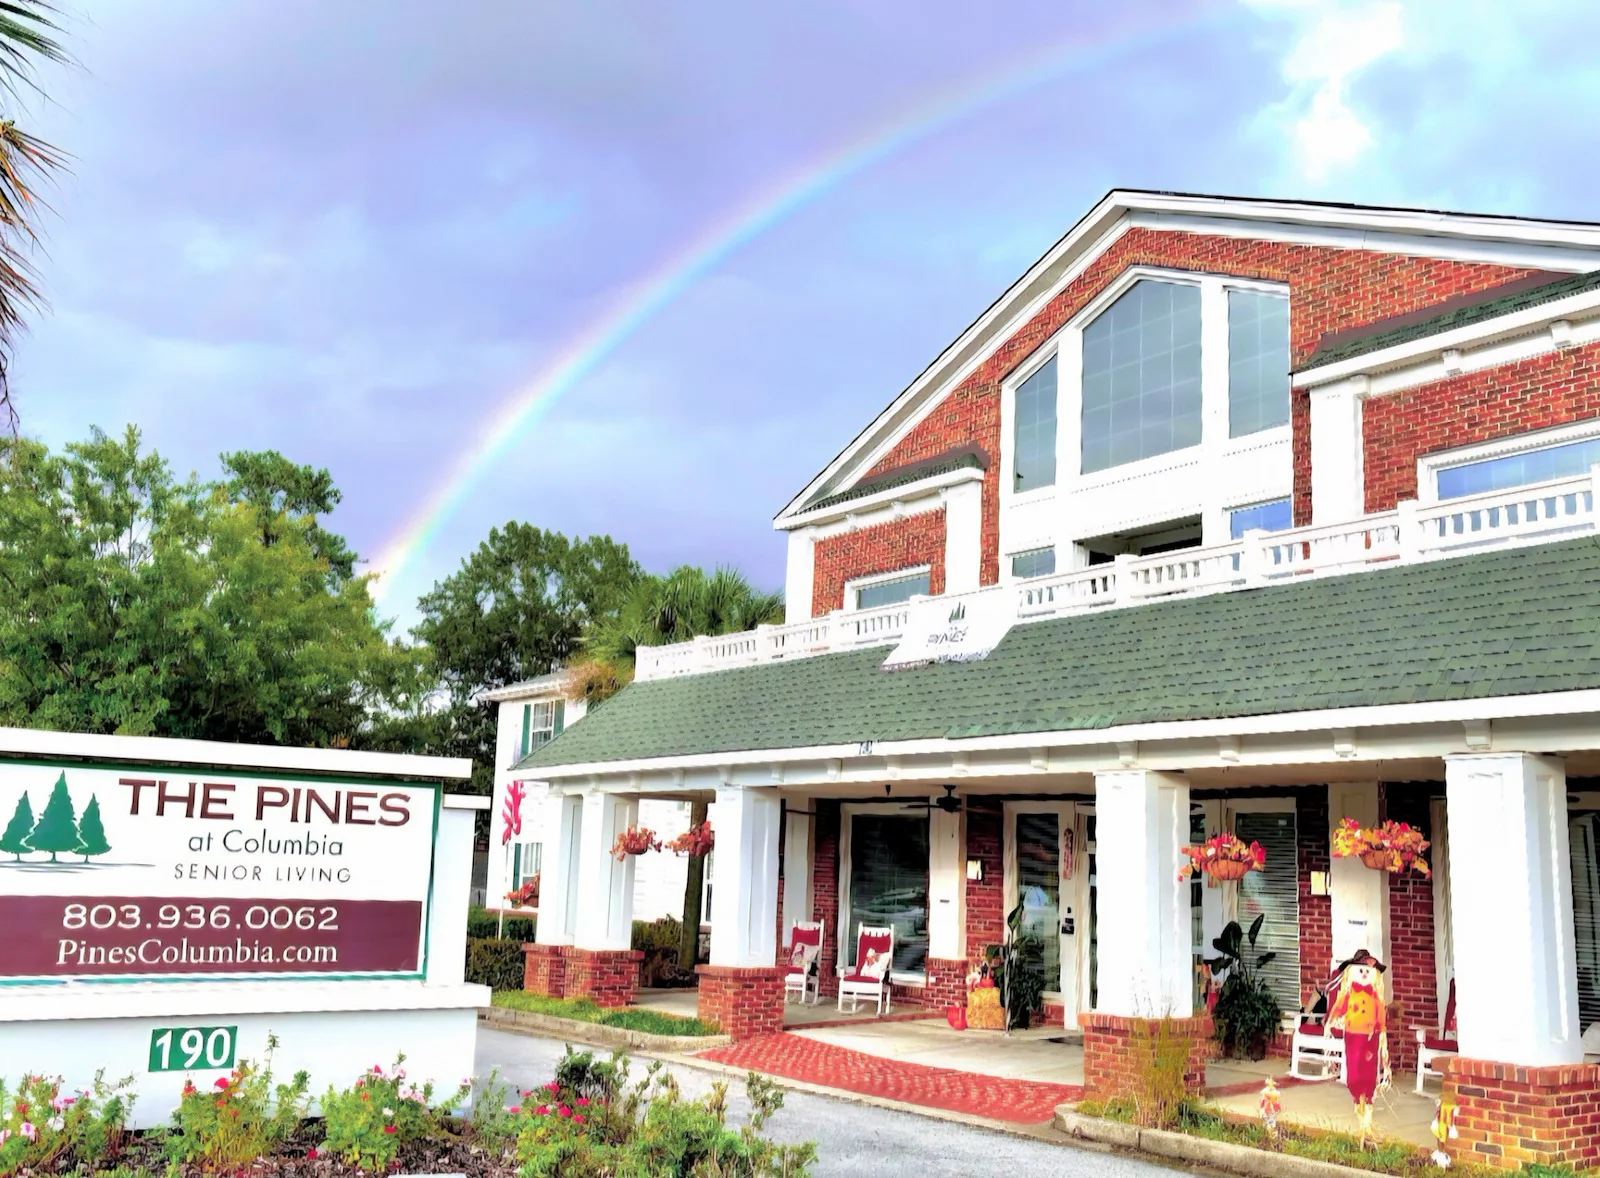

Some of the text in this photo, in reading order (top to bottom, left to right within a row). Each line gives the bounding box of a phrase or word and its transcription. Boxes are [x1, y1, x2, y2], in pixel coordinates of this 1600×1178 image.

[119, 778, 411, 827] THE PINES
[188, 828, 344, 857] at Columbia
[174, 863, 352, 884] SENIOR LIVING
[62, 904, 339, 931] 803.936.0062
[56, 938, 338, 966] PinesColumbia.com
[155, 1028, 232, 1069] 190
